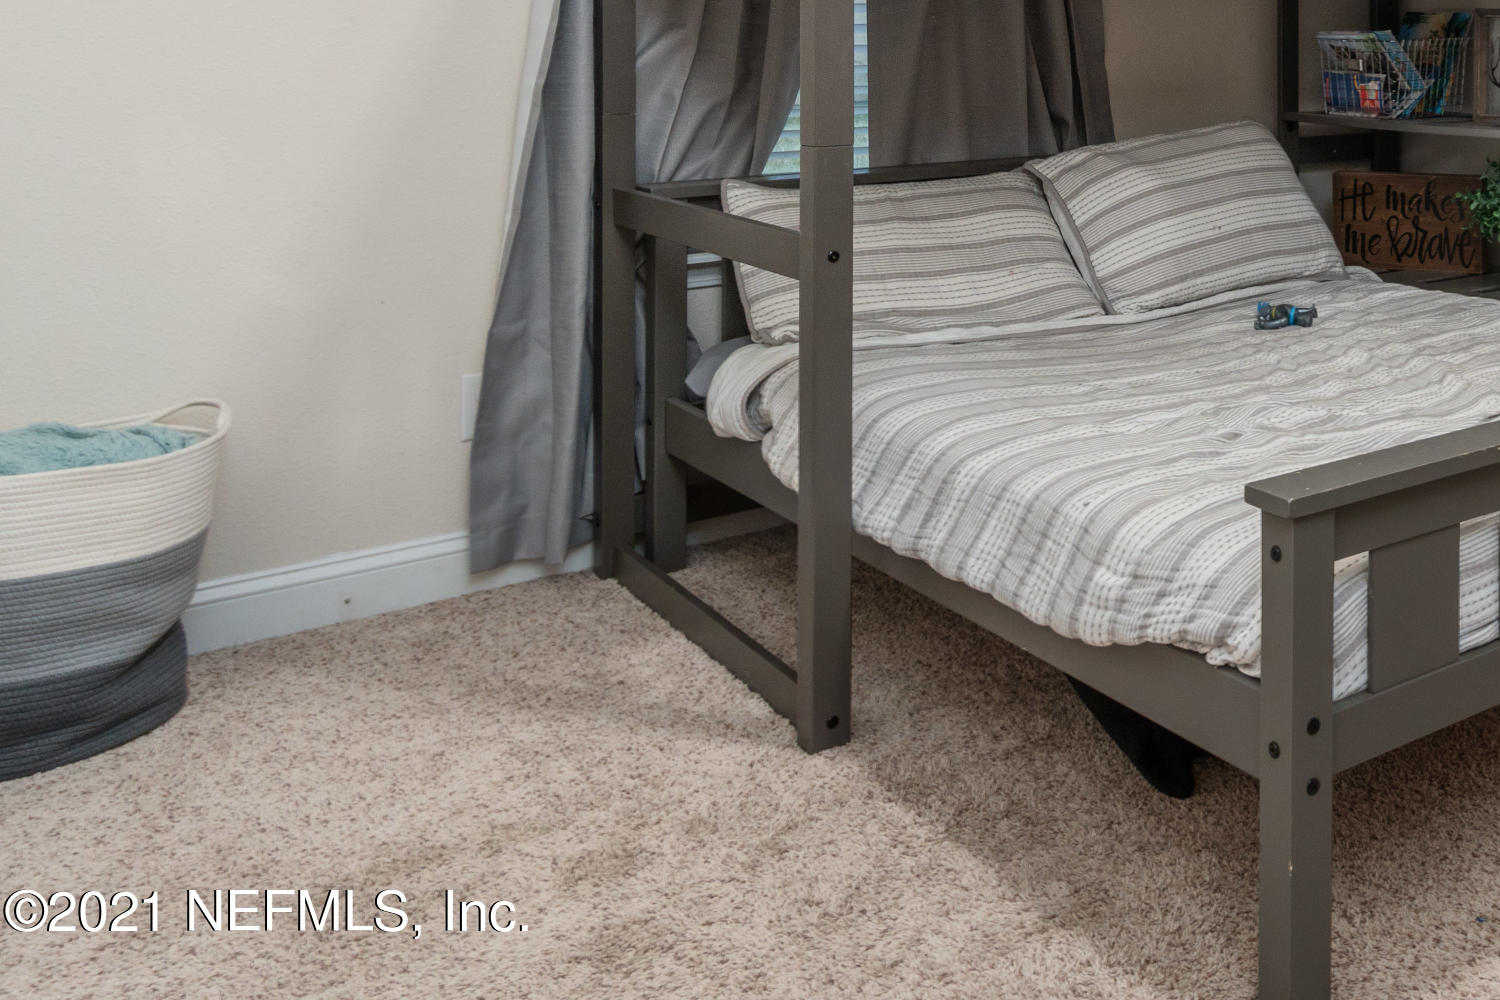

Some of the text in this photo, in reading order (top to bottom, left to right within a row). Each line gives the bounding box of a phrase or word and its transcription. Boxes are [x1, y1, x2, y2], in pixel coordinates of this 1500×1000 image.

[1339, 177, 1376, 222] He
[1345, 215, 1476, 268] me brave
